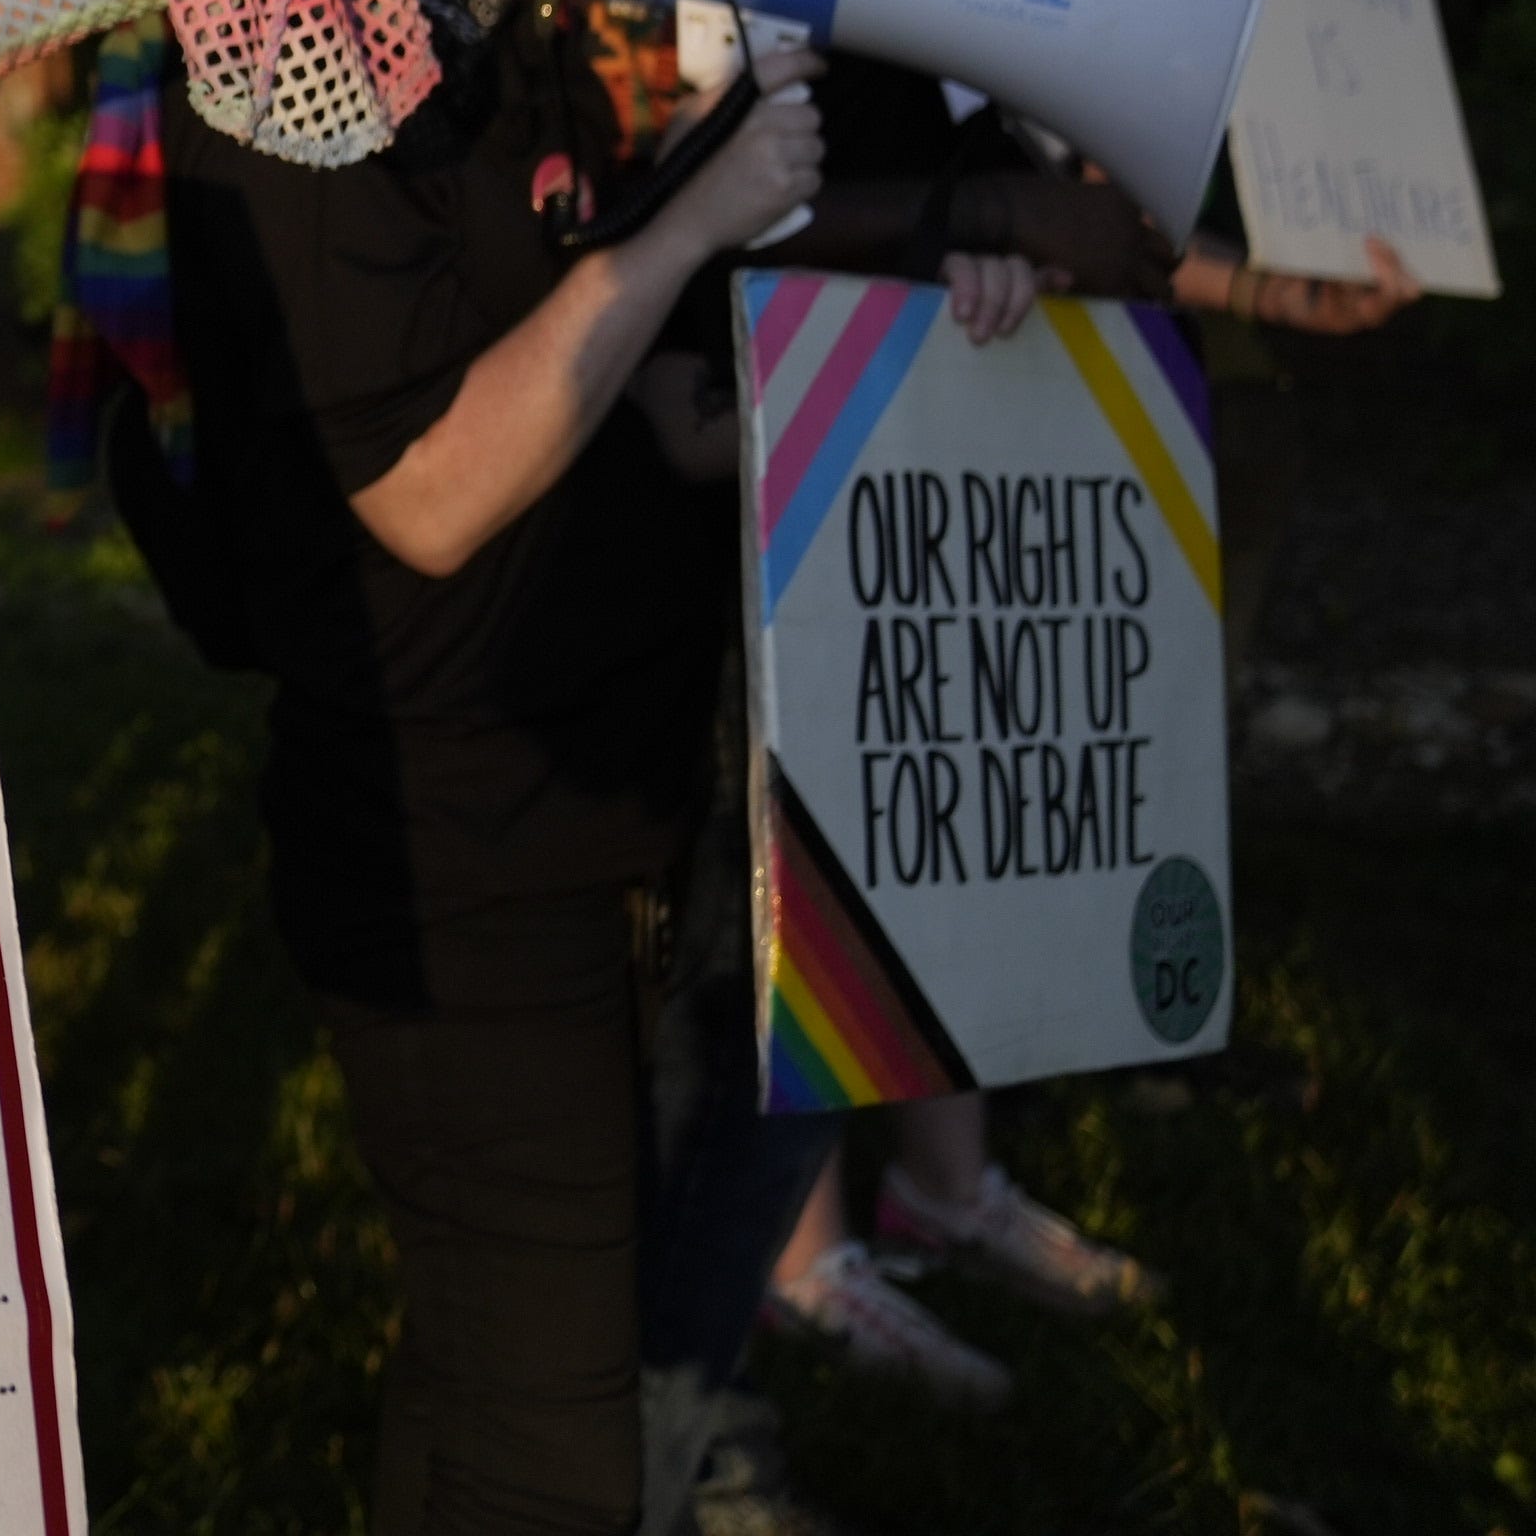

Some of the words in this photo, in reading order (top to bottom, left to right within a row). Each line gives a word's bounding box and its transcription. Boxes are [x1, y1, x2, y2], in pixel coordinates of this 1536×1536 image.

[848, 470, 955, 610] OUR
[967, 471, 1150, 611] RIGHTS
[856, 614, 962, 745] ARE
[971, 614, 1074, 739] NOT
[1082, 614, 1152, 735] UP
[862, 747, 967, 890] FOR
[980, 737, 1156, 881] DEBATE
[1155, 957, 1202, 1011] DC
